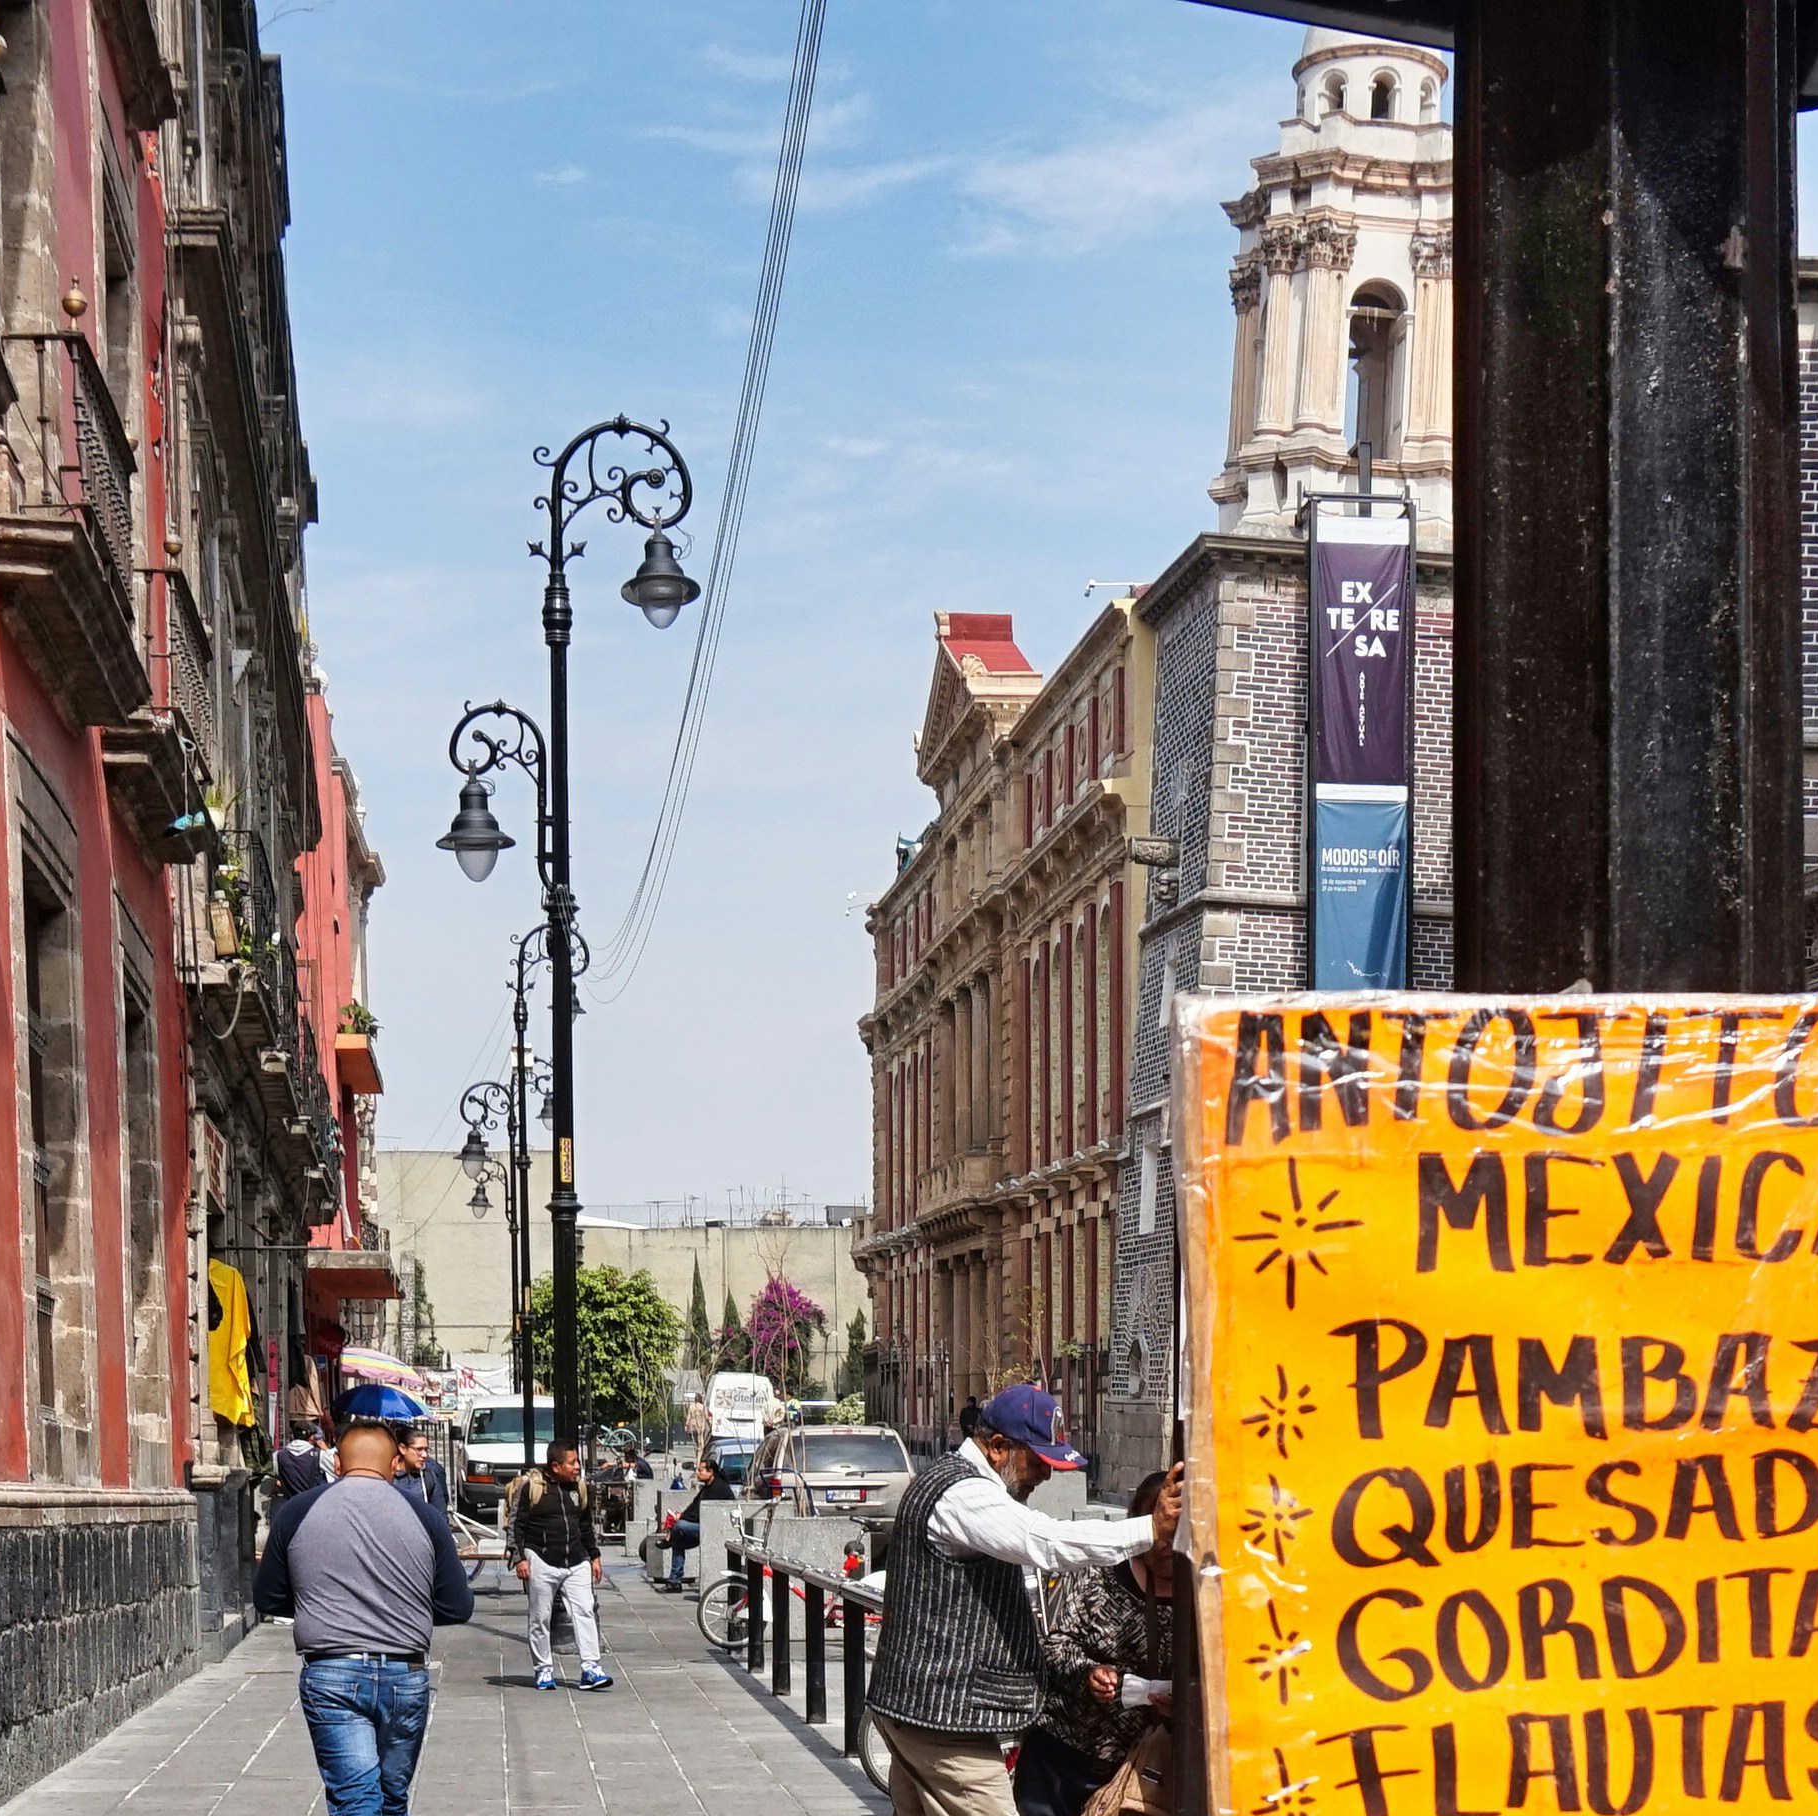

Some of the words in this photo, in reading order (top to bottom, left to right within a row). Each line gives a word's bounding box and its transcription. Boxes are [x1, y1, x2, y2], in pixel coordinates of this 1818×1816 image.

[1341, 581, 1373, 603] EX
[1326, 608, 1355, 630] TE
[1370, 609, 1400, 631] RE
[1354, 635, 1387, 657] SA
[1321, 848, 1368, 866] MODOS
[1378, 844, 1400, 867] OÍR
